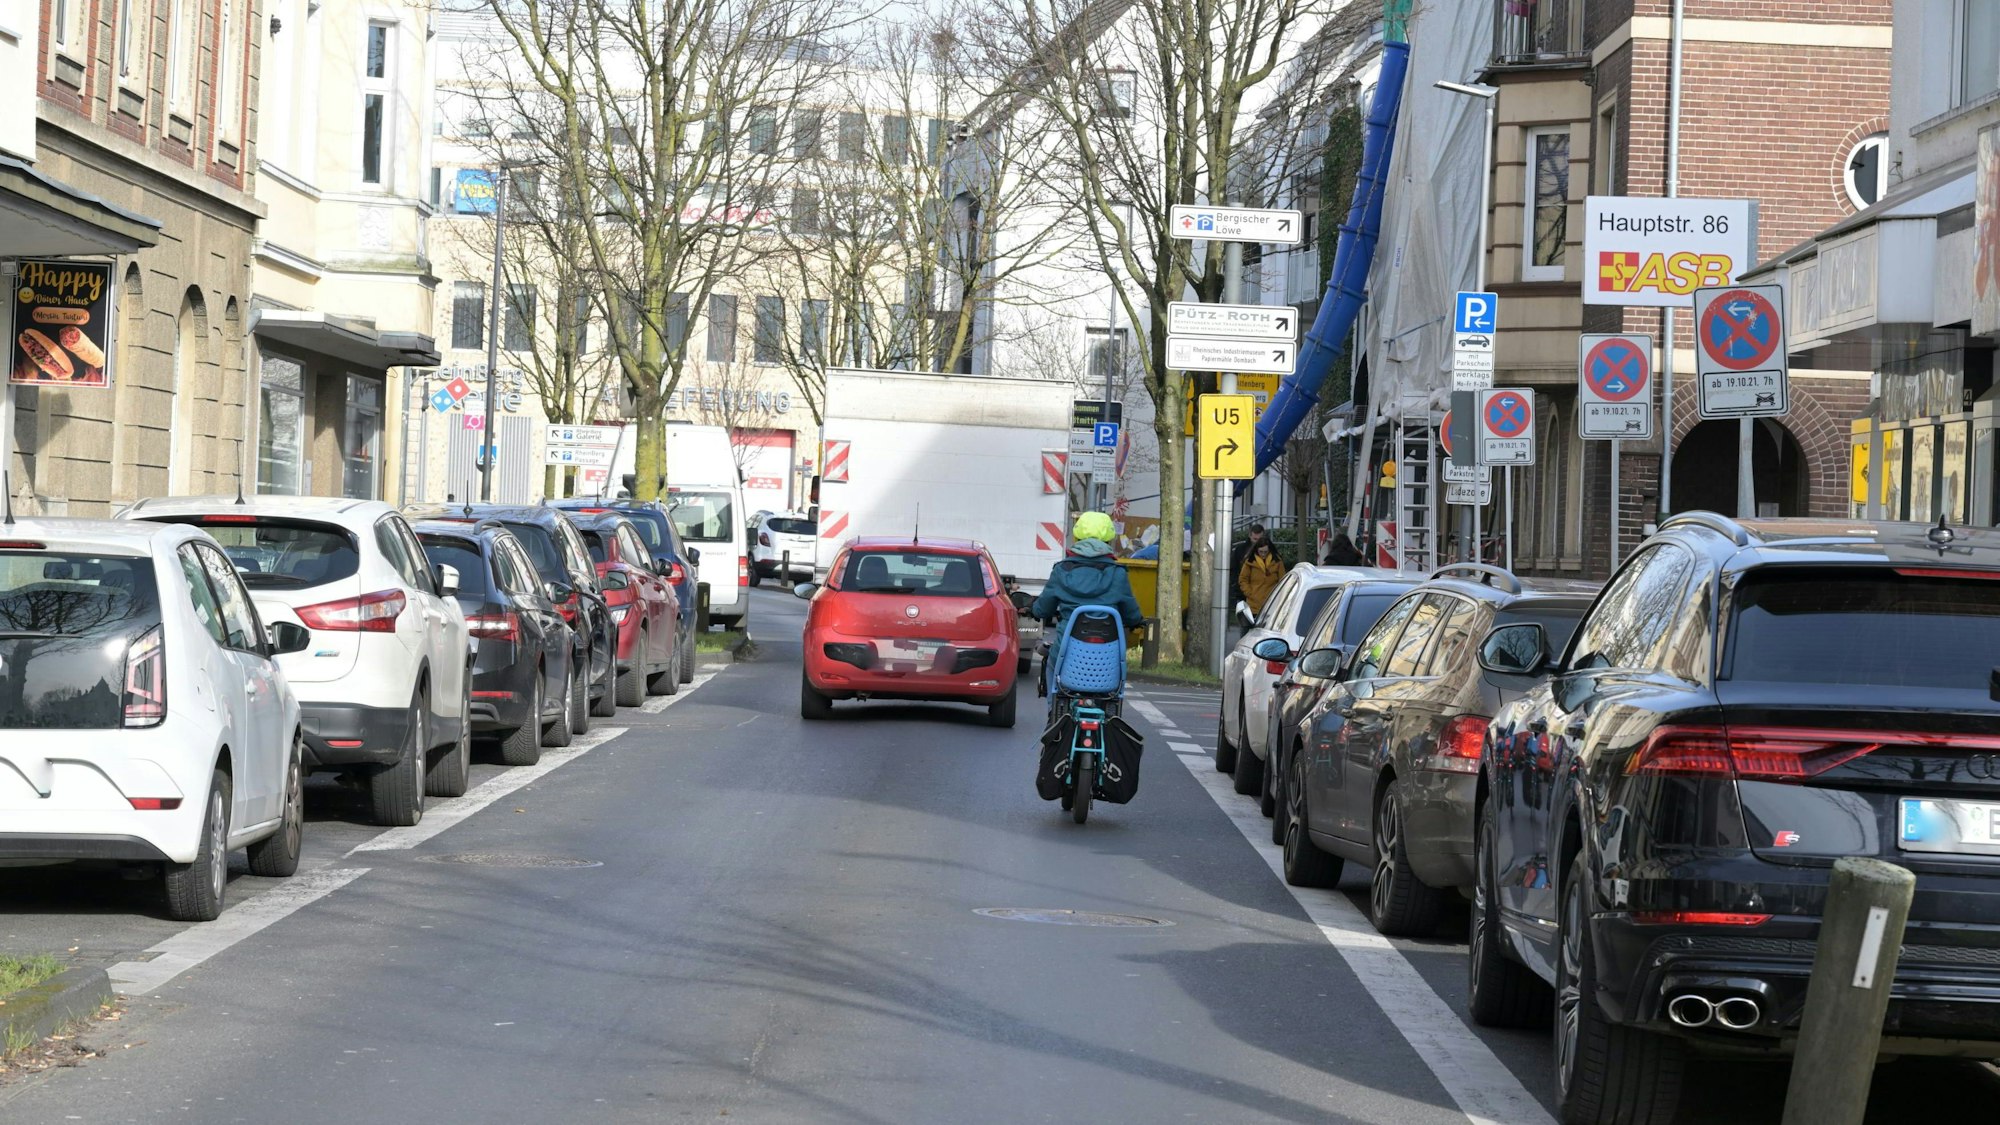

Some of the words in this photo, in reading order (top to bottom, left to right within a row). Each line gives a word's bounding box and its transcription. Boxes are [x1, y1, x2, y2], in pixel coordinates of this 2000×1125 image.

[1216, 212, 1270, 224] Bergischer
[1216, 225, 1242, 235] Löwe
[1599, 212, 1694, 237] Hauptstr.
[1703, 214, 1729, 234] 86
[1627, 251, 1733, 296] ASB
[20, 262, 106, 301] Happy
[33, 293, 61, 306] Döner
[64, 295, 90, 306] Haus
[1223, 348, 1266, 356] Industriemuseum
[1233, 356, 1257, 364] Dombach
[1456, 371, 1490, 380] werktags
[1711, 379, 1722, 389] ab
[1726, 378, 1760, 388] 19.10.21.
[1763, 377, 1774, 387] 7h
[1214, 408, 1240, 426] U5
[1591, 407, 1599, 416] ab
[1632, 407, 1641, 416] 7h
